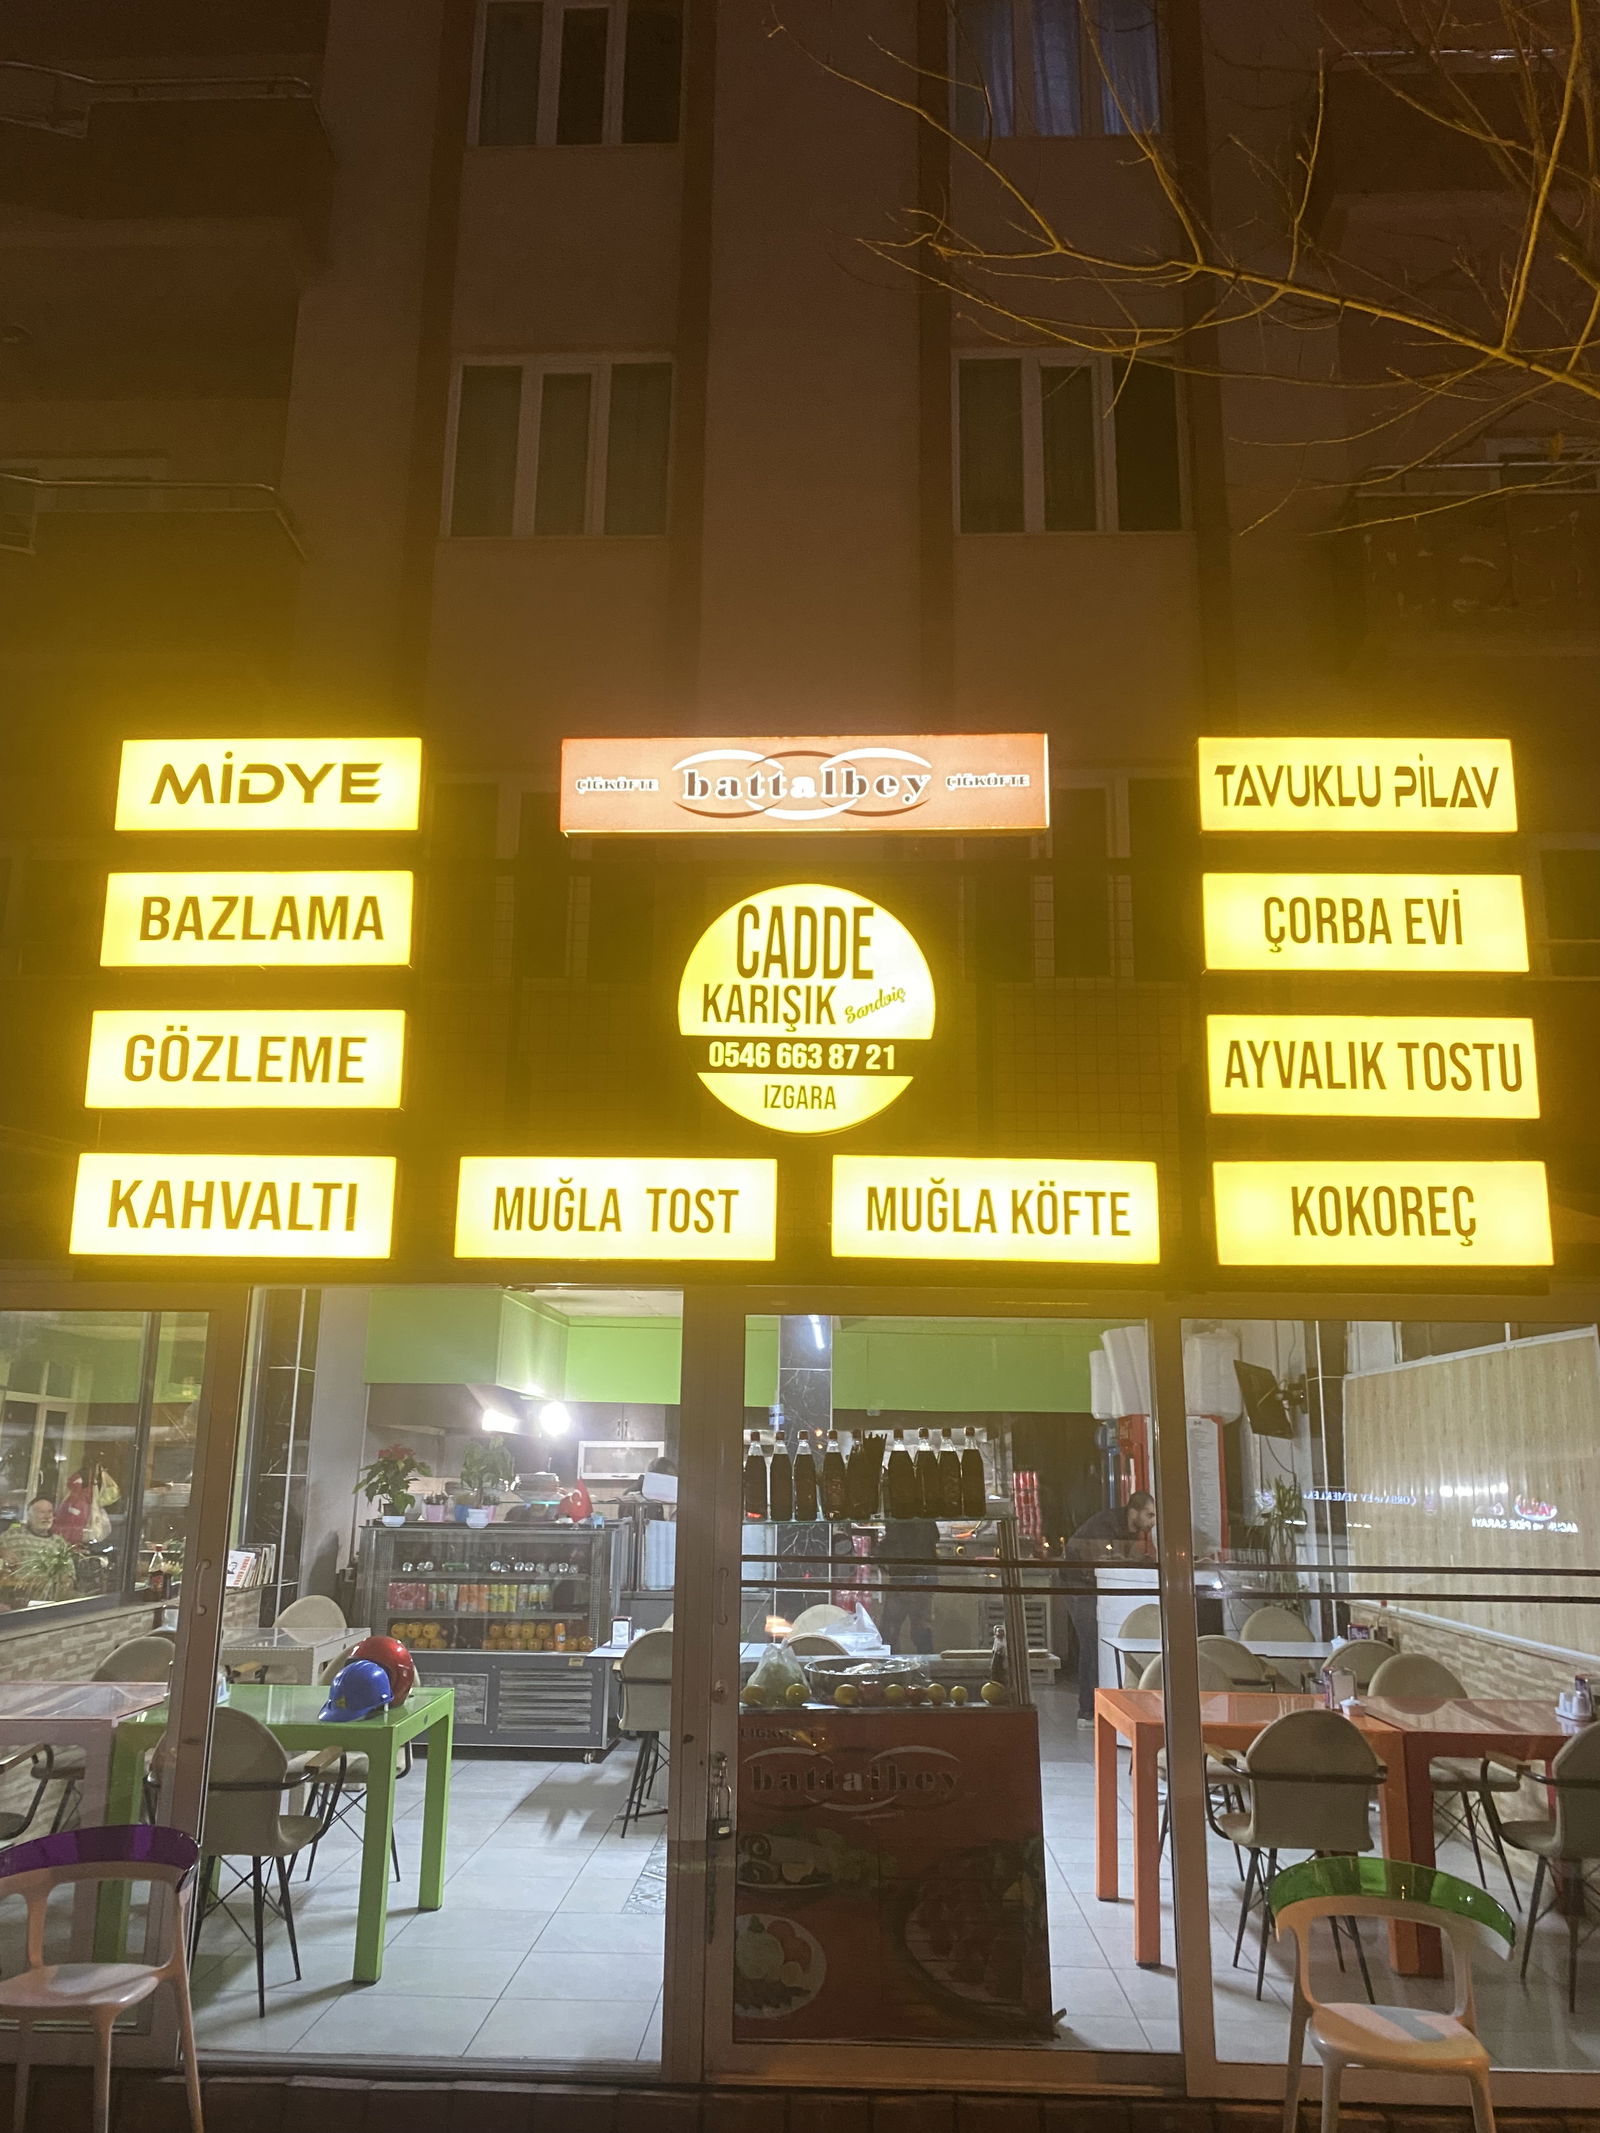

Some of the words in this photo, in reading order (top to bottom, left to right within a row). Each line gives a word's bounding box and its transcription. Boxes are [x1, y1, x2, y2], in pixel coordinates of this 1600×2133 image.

[150, 752, 382, 805] MİDYE
[683, 767, 931, 804] battalbey
[1215, 765, 1381, 807] TAVUKLU
[1394, 753, 1499, 808] PİLAV
[139, 896, 384, 941] BAZLAMA
[736, 904, 874, 980] CADDE
[1264, 897, 1392, 953] ÇORBA
[1405, 889, 1463, 945] EVİ
[702, 984, 836, 1032] KARIŞIK
[845, 986, 906, 1024] Sandviç
[124, 1026, 367, 1083] GÖZLEME
[709, 1041, 771, 1067] 0546
[776, 1042, 822, 1069] 663
[828, 1043, 860, 1069] 87
[865, 1044, 895, 1070] 21
[1224, 1041, 1386, 1090] AYVALIK
[1397, 1042, 1523, 1092] TOSTU
[763, 1085, 837, 1110] IZGARA
[108, 1179, 358, 1232] KAHVALTI
[493, 1177, 622, 1232] MUĞLA
[647, 1188, 740, 1234] TOST
[867, 1177, 997, 1234] MUĞLA
[1011, 1181, 1131, 1236] KÖFTE
[1291, 1186, 1477, 1246] KOKOREÇ
